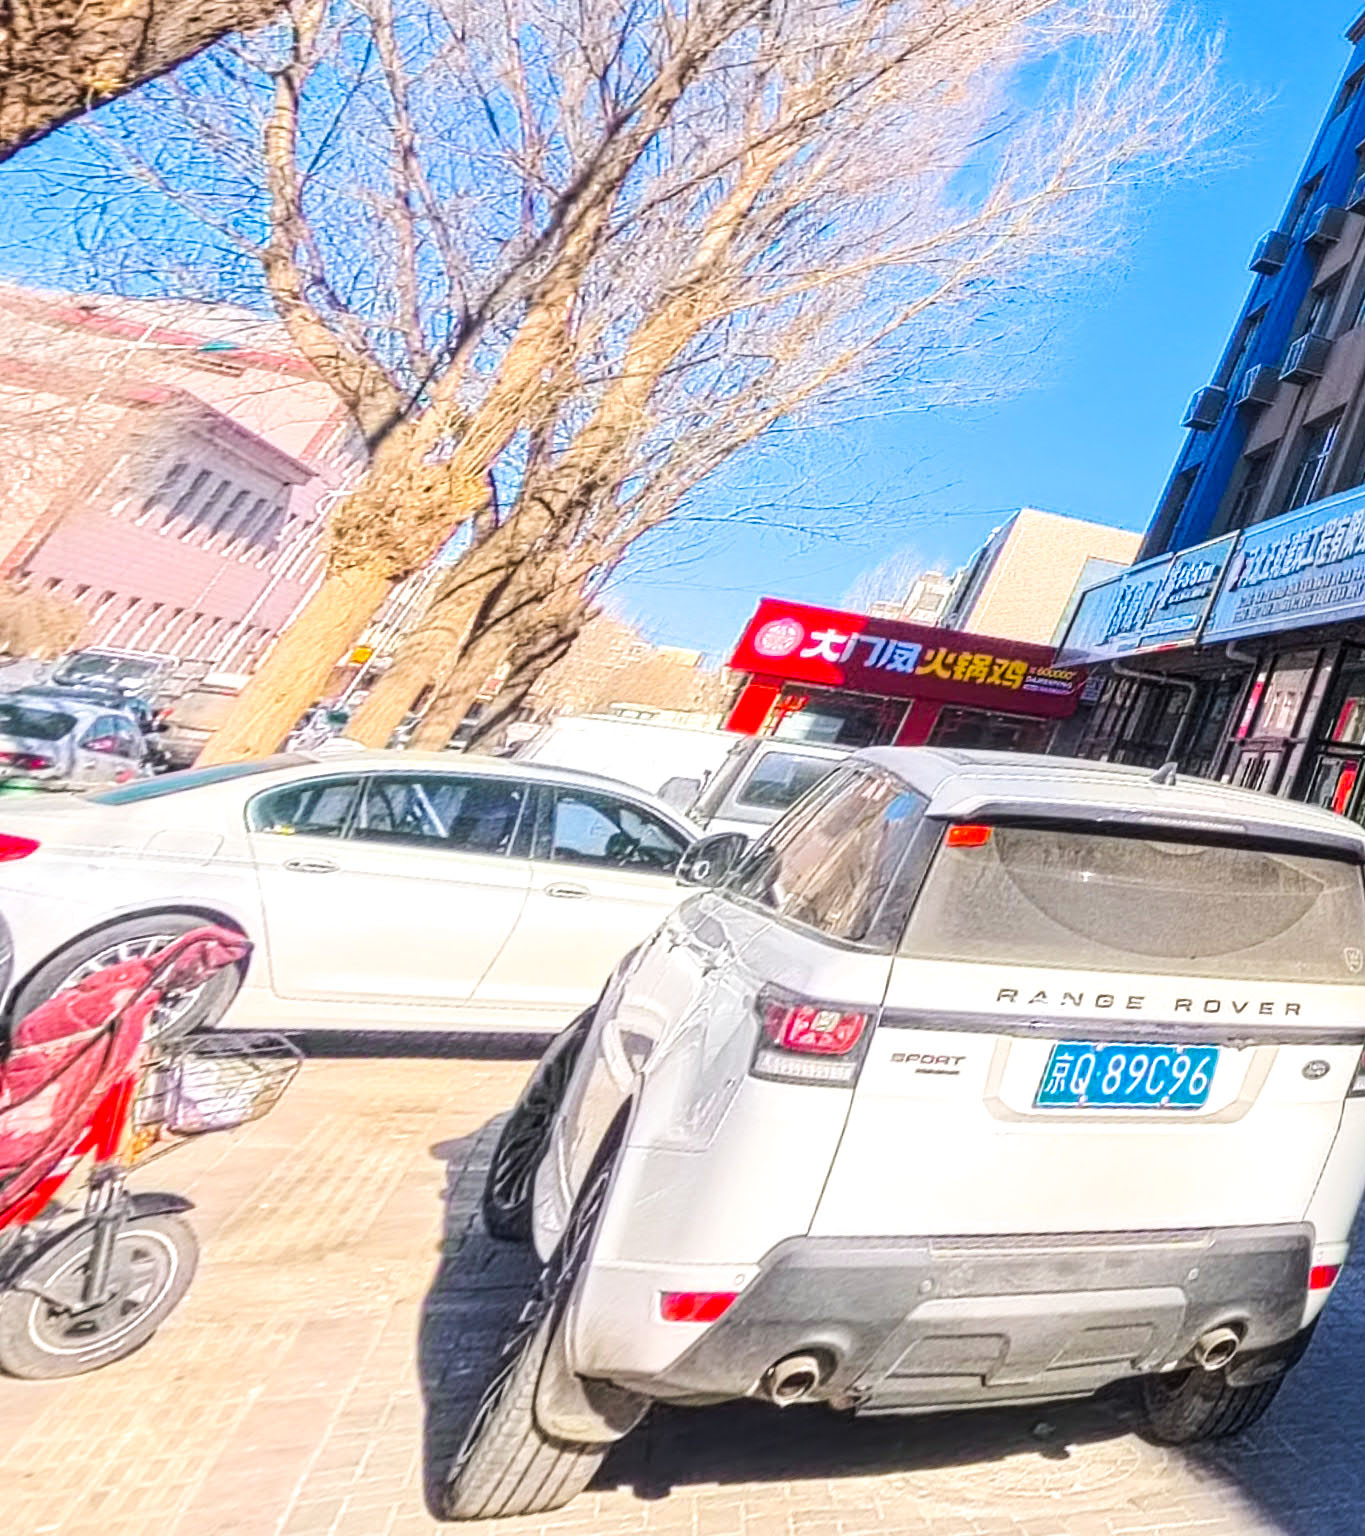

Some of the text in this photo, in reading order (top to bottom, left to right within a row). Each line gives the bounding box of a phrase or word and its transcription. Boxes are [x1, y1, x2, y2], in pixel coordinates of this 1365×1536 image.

[996, 988, 1302, 1016] RANGE ROVER
[890, 1052, 967, 1066] SPORT
